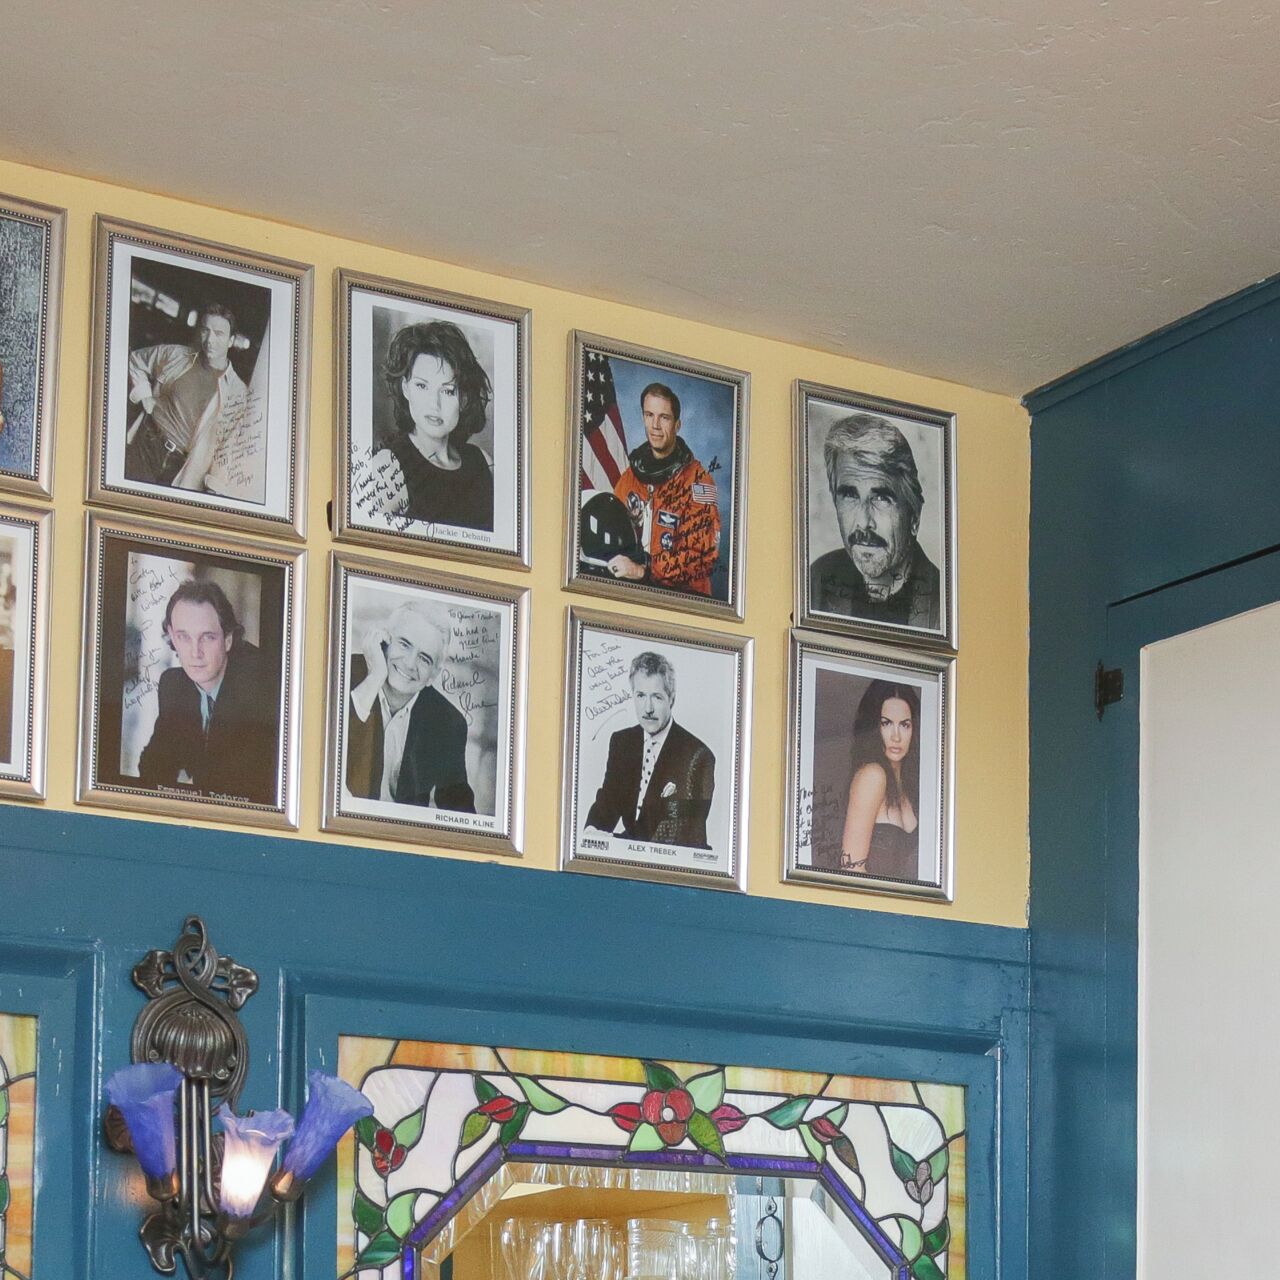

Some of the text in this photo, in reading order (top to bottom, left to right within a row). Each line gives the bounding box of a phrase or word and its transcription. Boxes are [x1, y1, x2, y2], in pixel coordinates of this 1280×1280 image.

[435, 526, 459, 538] Jackie
[157, 784, 202, 797] Emmanuel
[435, 814, 495, 829] RICHARD KLINE
[628, 844, 677, 857] ALEX TREBEK
